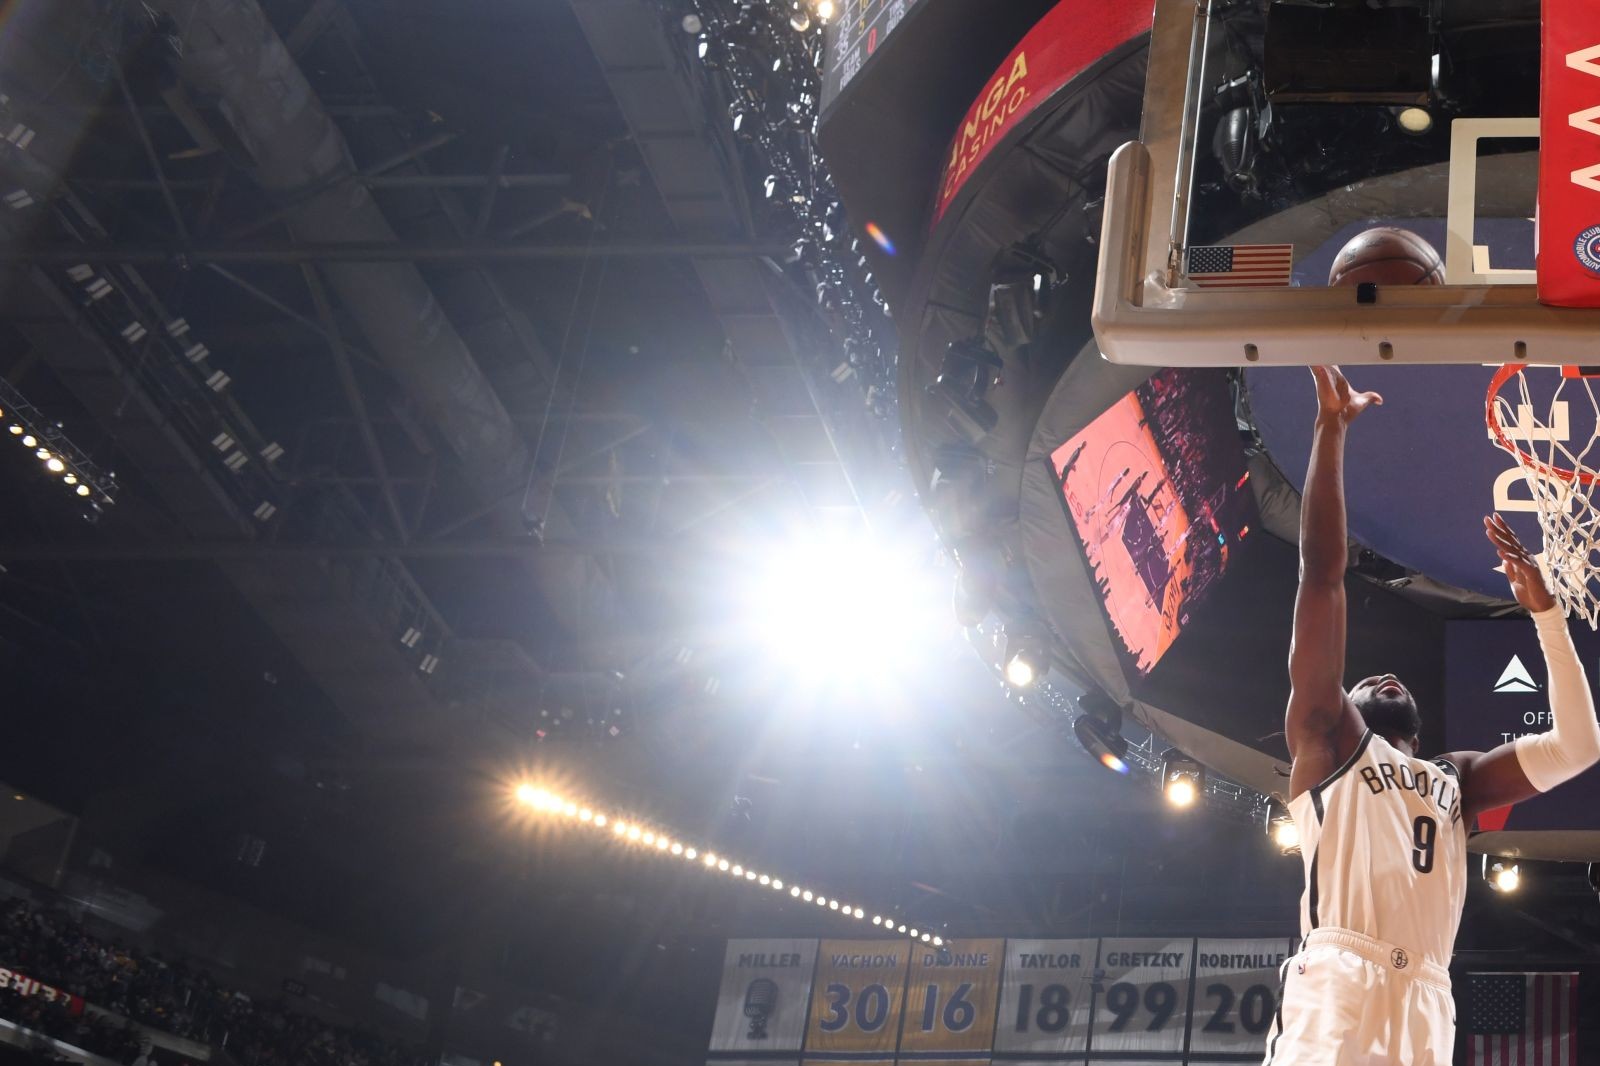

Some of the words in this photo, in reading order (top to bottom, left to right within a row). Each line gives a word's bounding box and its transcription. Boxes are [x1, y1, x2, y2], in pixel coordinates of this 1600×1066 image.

[1576, 237, 1600, 270] AUTOMOBILE
[1412, 815, 1436, 874] 9
[738, 953, 800, 969] MILLER
[831, 954, 897, 969] VACHON
[1020, 954, 1080, 968] TAYLOR
[1107, 953, 1184, 968] GRETZKY
[1200, 954, 1285, 969] ROBITAILLE
[820, 983, 889, 1033] 30
[921, 983, 976, 1033] 16
[1015, 984, 1072, 1034] 18
[1106, 982, 1178, 1033] 99
[1202, 983, 1277, 1035] 20
